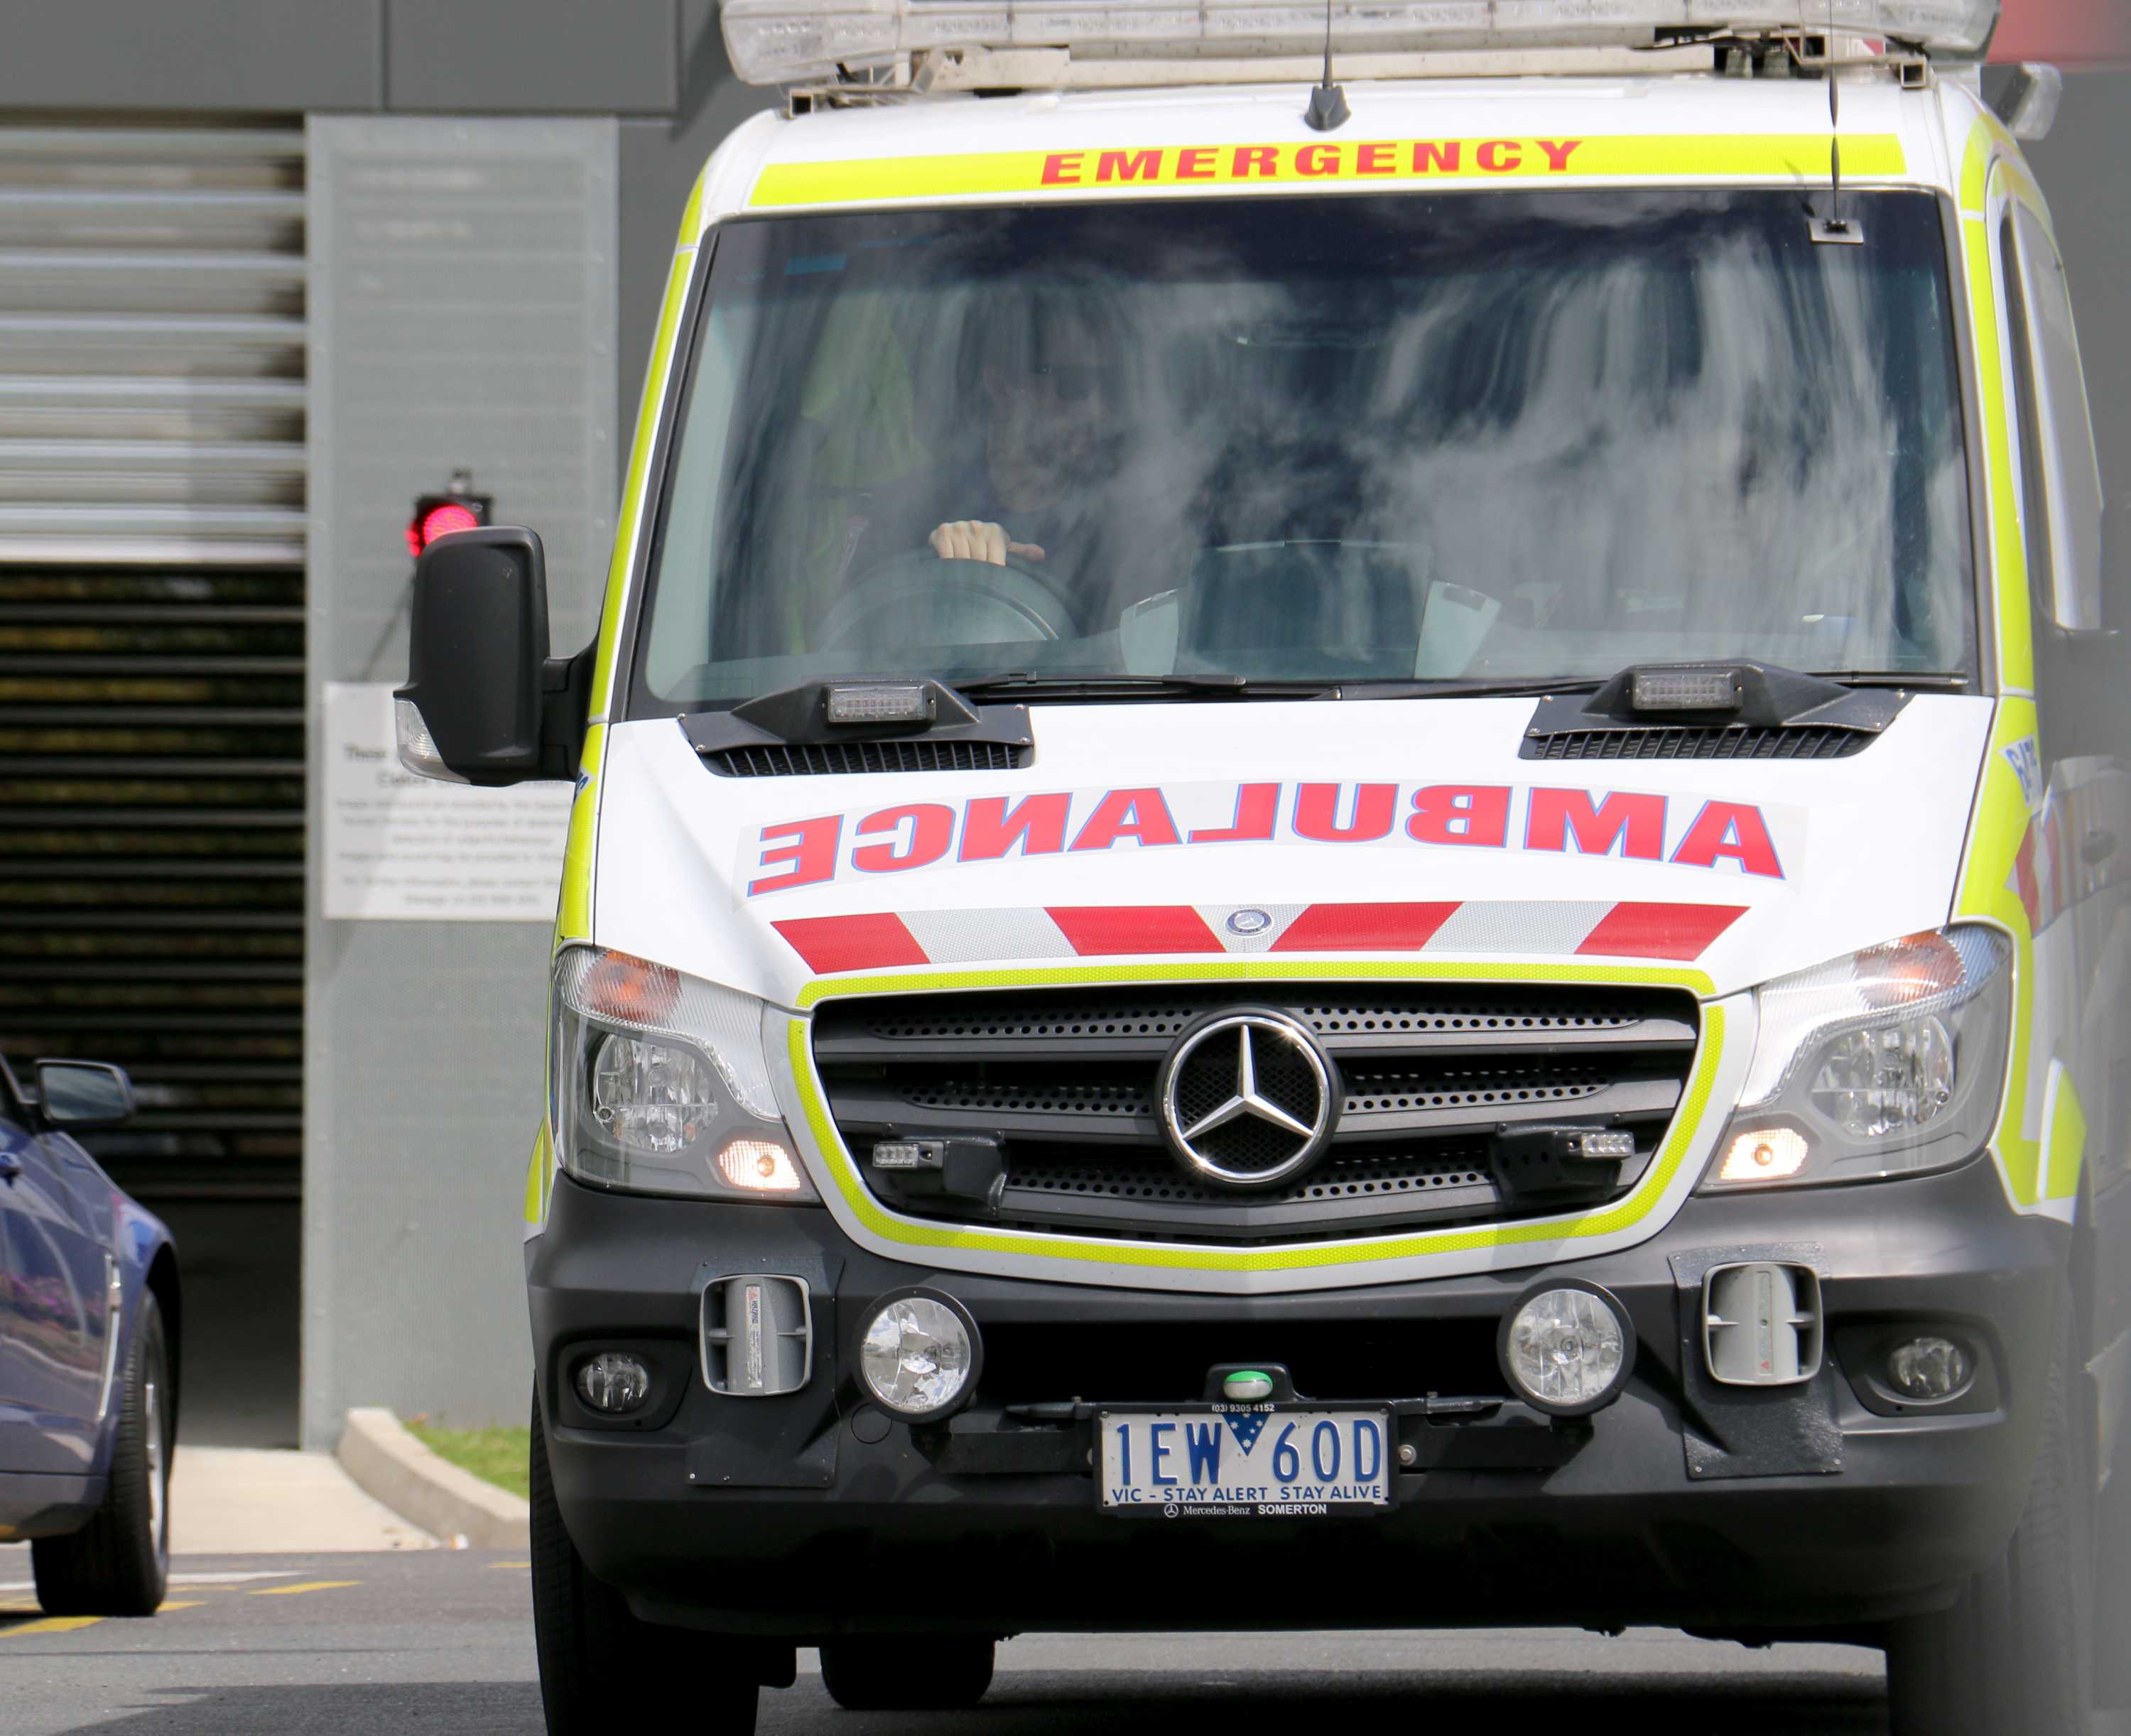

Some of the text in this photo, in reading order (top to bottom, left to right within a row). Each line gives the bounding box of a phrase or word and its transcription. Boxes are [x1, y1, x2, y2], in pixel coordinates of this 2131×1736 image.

[1041, 140, 1583, 185] EMERGENCY
[1211, 1404, 1275, 1413] (03) 9305 4152
[1117, 1419, 1382, 1485] 1EW 60D
[1112, 1488, 1142, 1502] VIC
[1164, 1487, 1208, 1502] STAY
[1213, 1487, 1269, 1501] ALERT
[1280, 1486, 1325, 1500] STAY
[1330, 1485, 1381, 1499] ALIVE
[1183, 1504, 1328, 1516] Mercedes-Benz SOMERTON
